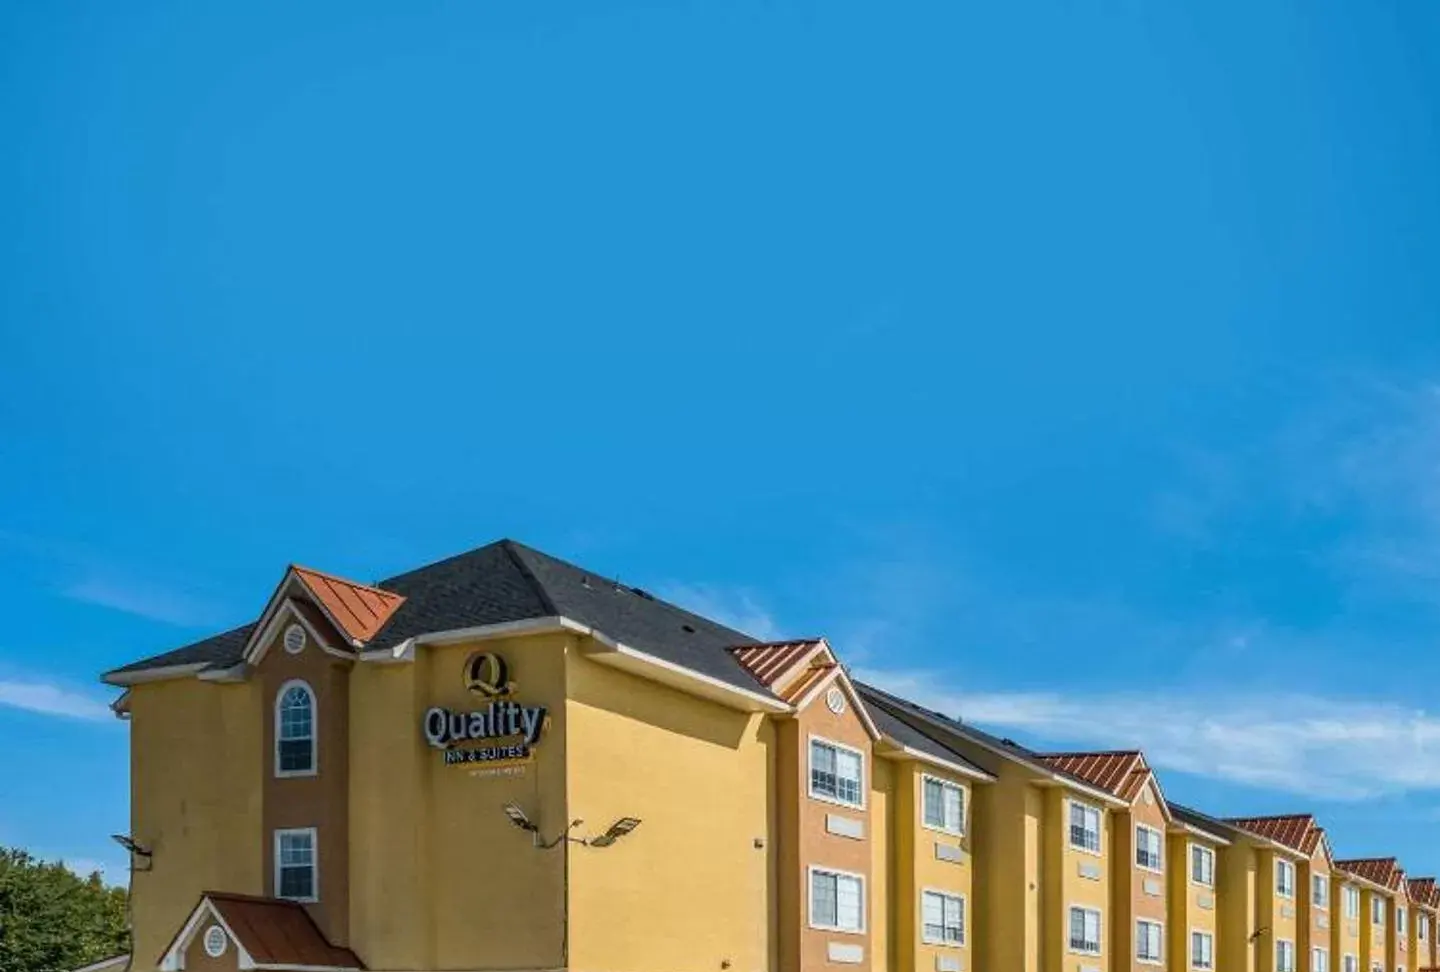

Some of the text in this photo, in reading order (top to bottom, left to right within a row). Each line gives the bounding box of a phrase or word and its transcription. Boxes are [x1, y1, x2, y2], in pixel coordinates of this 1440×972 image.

[424, 701, 541, 749] Quality
[444, 751, 464, 765] INN
[480, 746, 523, 759] SUITES
